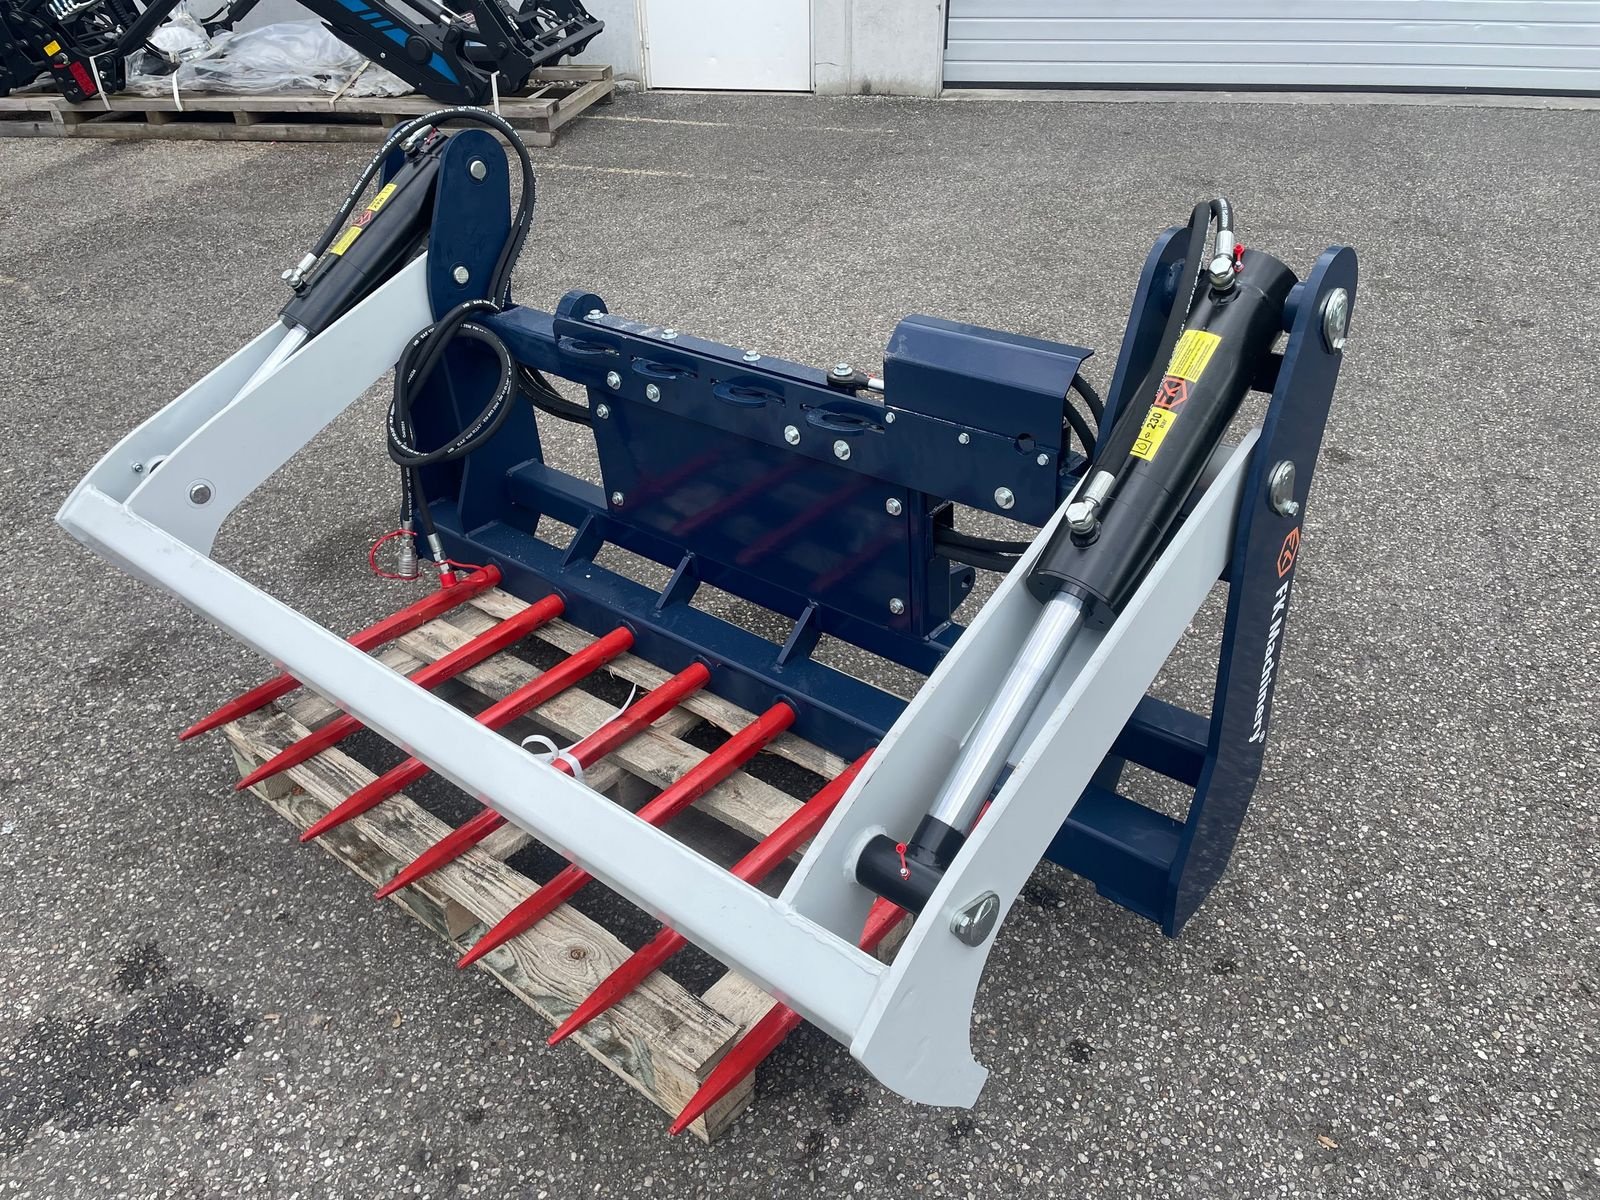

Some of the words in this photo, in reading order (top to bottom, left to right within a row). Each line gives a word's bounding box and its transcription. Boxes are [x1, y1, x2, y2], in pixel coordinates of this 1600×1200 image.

[1146, 412, 1162, 430] 230
[1272, 580, 1288, 620] FK
[1249, 618, 1282, 742] Machinery
